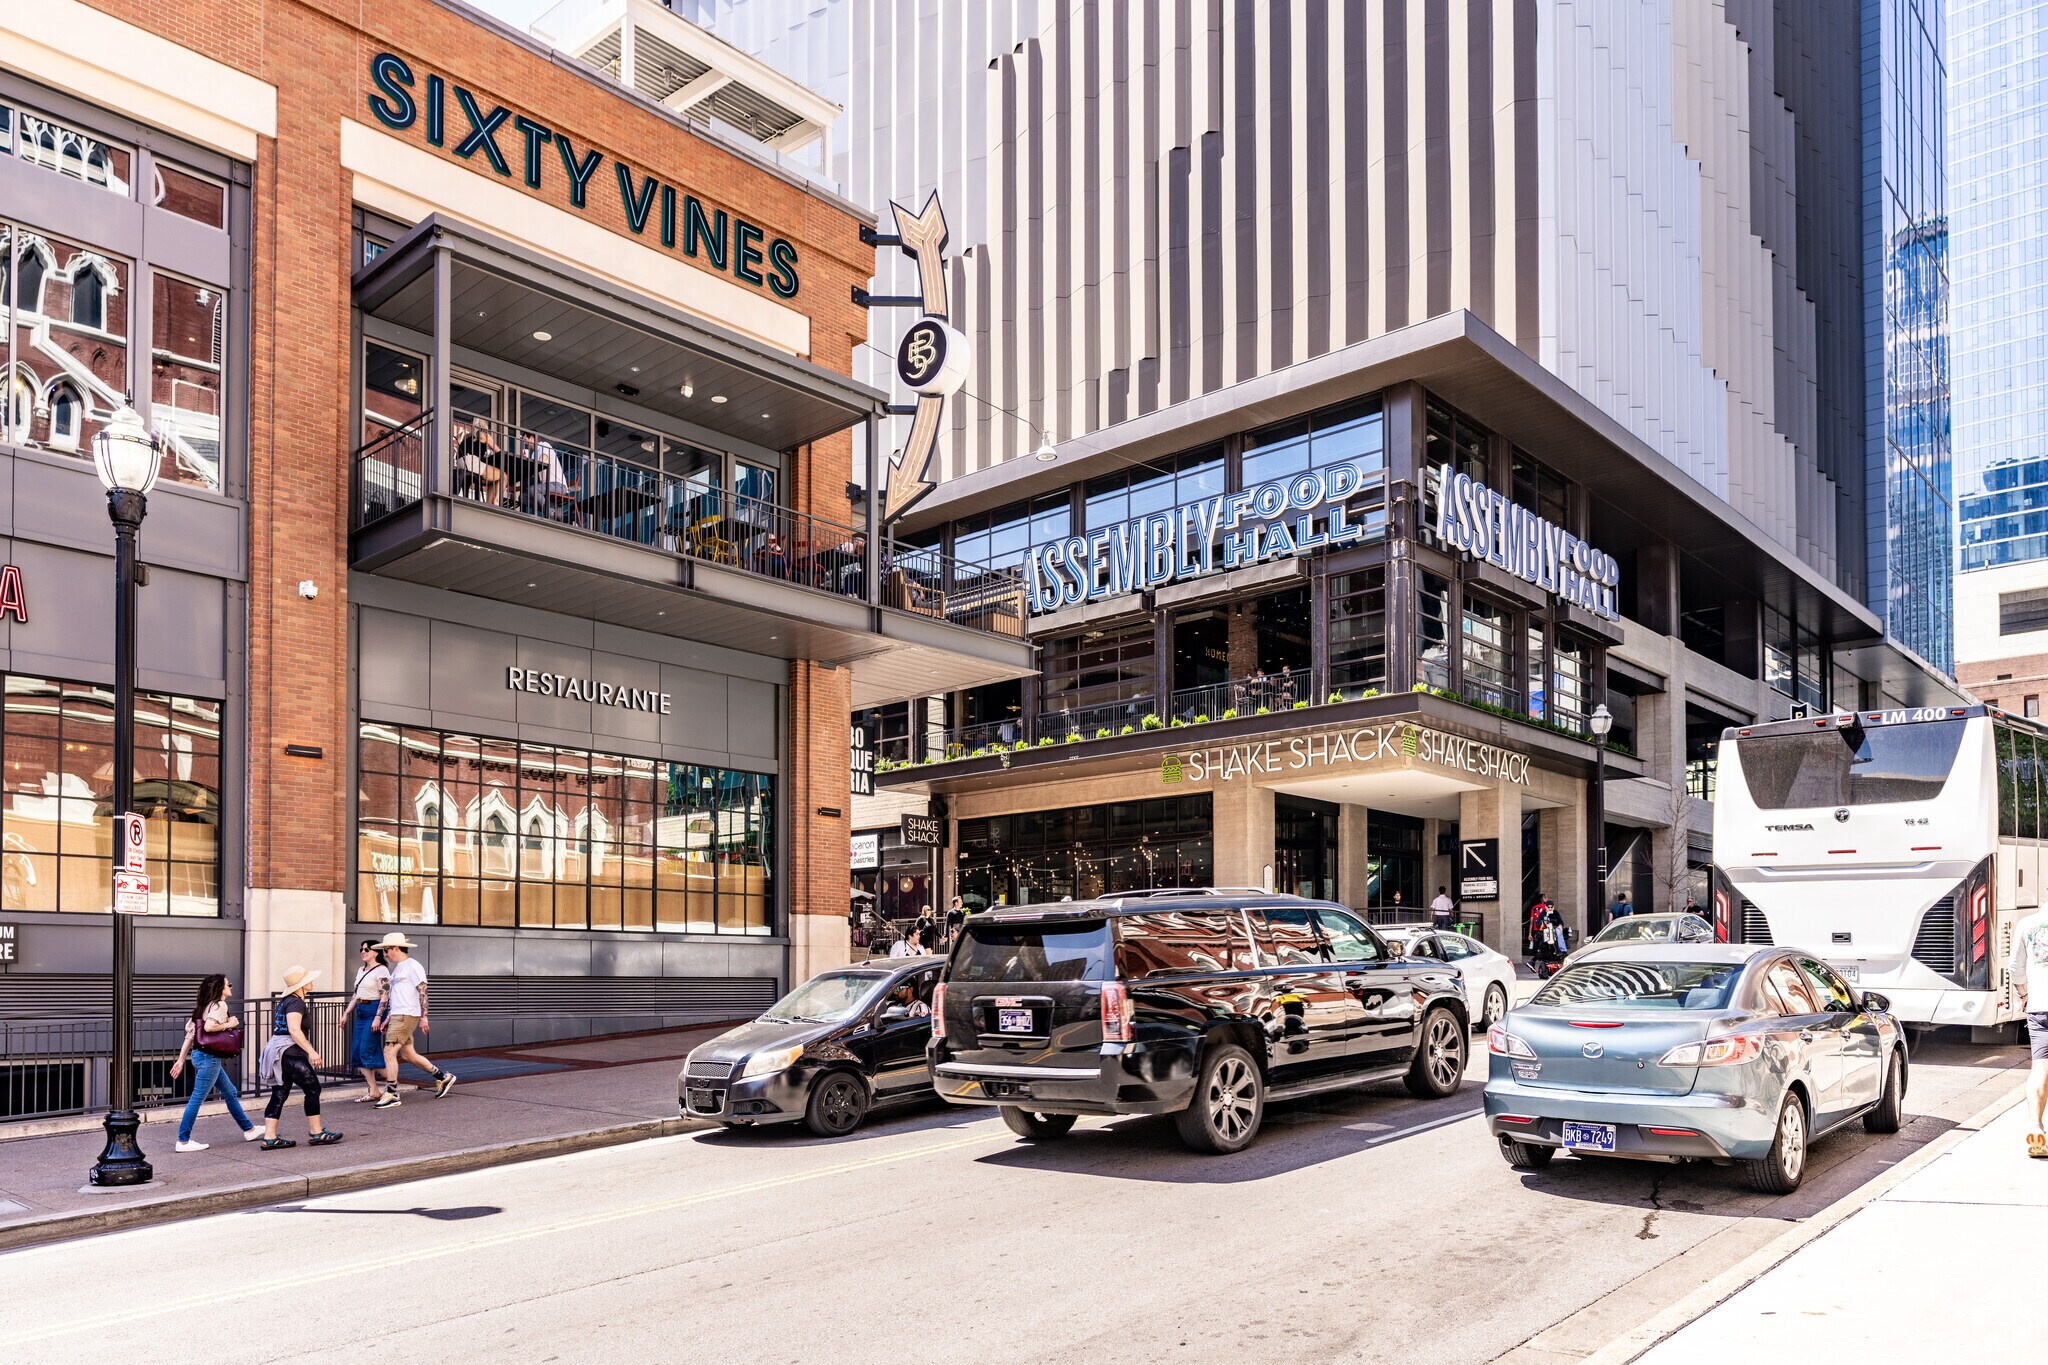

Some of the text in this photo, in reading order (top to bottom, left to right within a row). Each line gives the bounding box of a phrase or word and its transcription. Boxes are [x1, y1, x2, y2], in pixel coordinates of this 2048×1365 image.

[368, 52, 800, 299] SIXTY VINES
[1223, 462, 1363, 529] FOOD
[1022, 497, 1223, 613] ASSEMBLY
[1223, 505, 1363, 569] HALL
[1436, 463, 1562, 594] ASSEMBLY
[1560, 530, 1620, 587] FOOD
[0, 565, 28, 624] A
[1560, 566, 1620, 622] HALL
[507, 666, 671, 715] RESTAURANTE
[1795, 711, 1804, 720] P
[1882, 707, 1947, 725] LM 400
[1189, 725, 1400, 781] SHAKE SHACK
[1419, 729, 1530, 787] SHAKE SHACK
[908, 817, 939, 832] SHAKE
[908, 830, 940, 844] SHACK
[1765, 823, 1815, 832] TEMSA
[0, 926, 14, 939] M
[994, 997, 1022, 1007] GMC
[1565, 1128, 1613, 1145] BKB 7249
